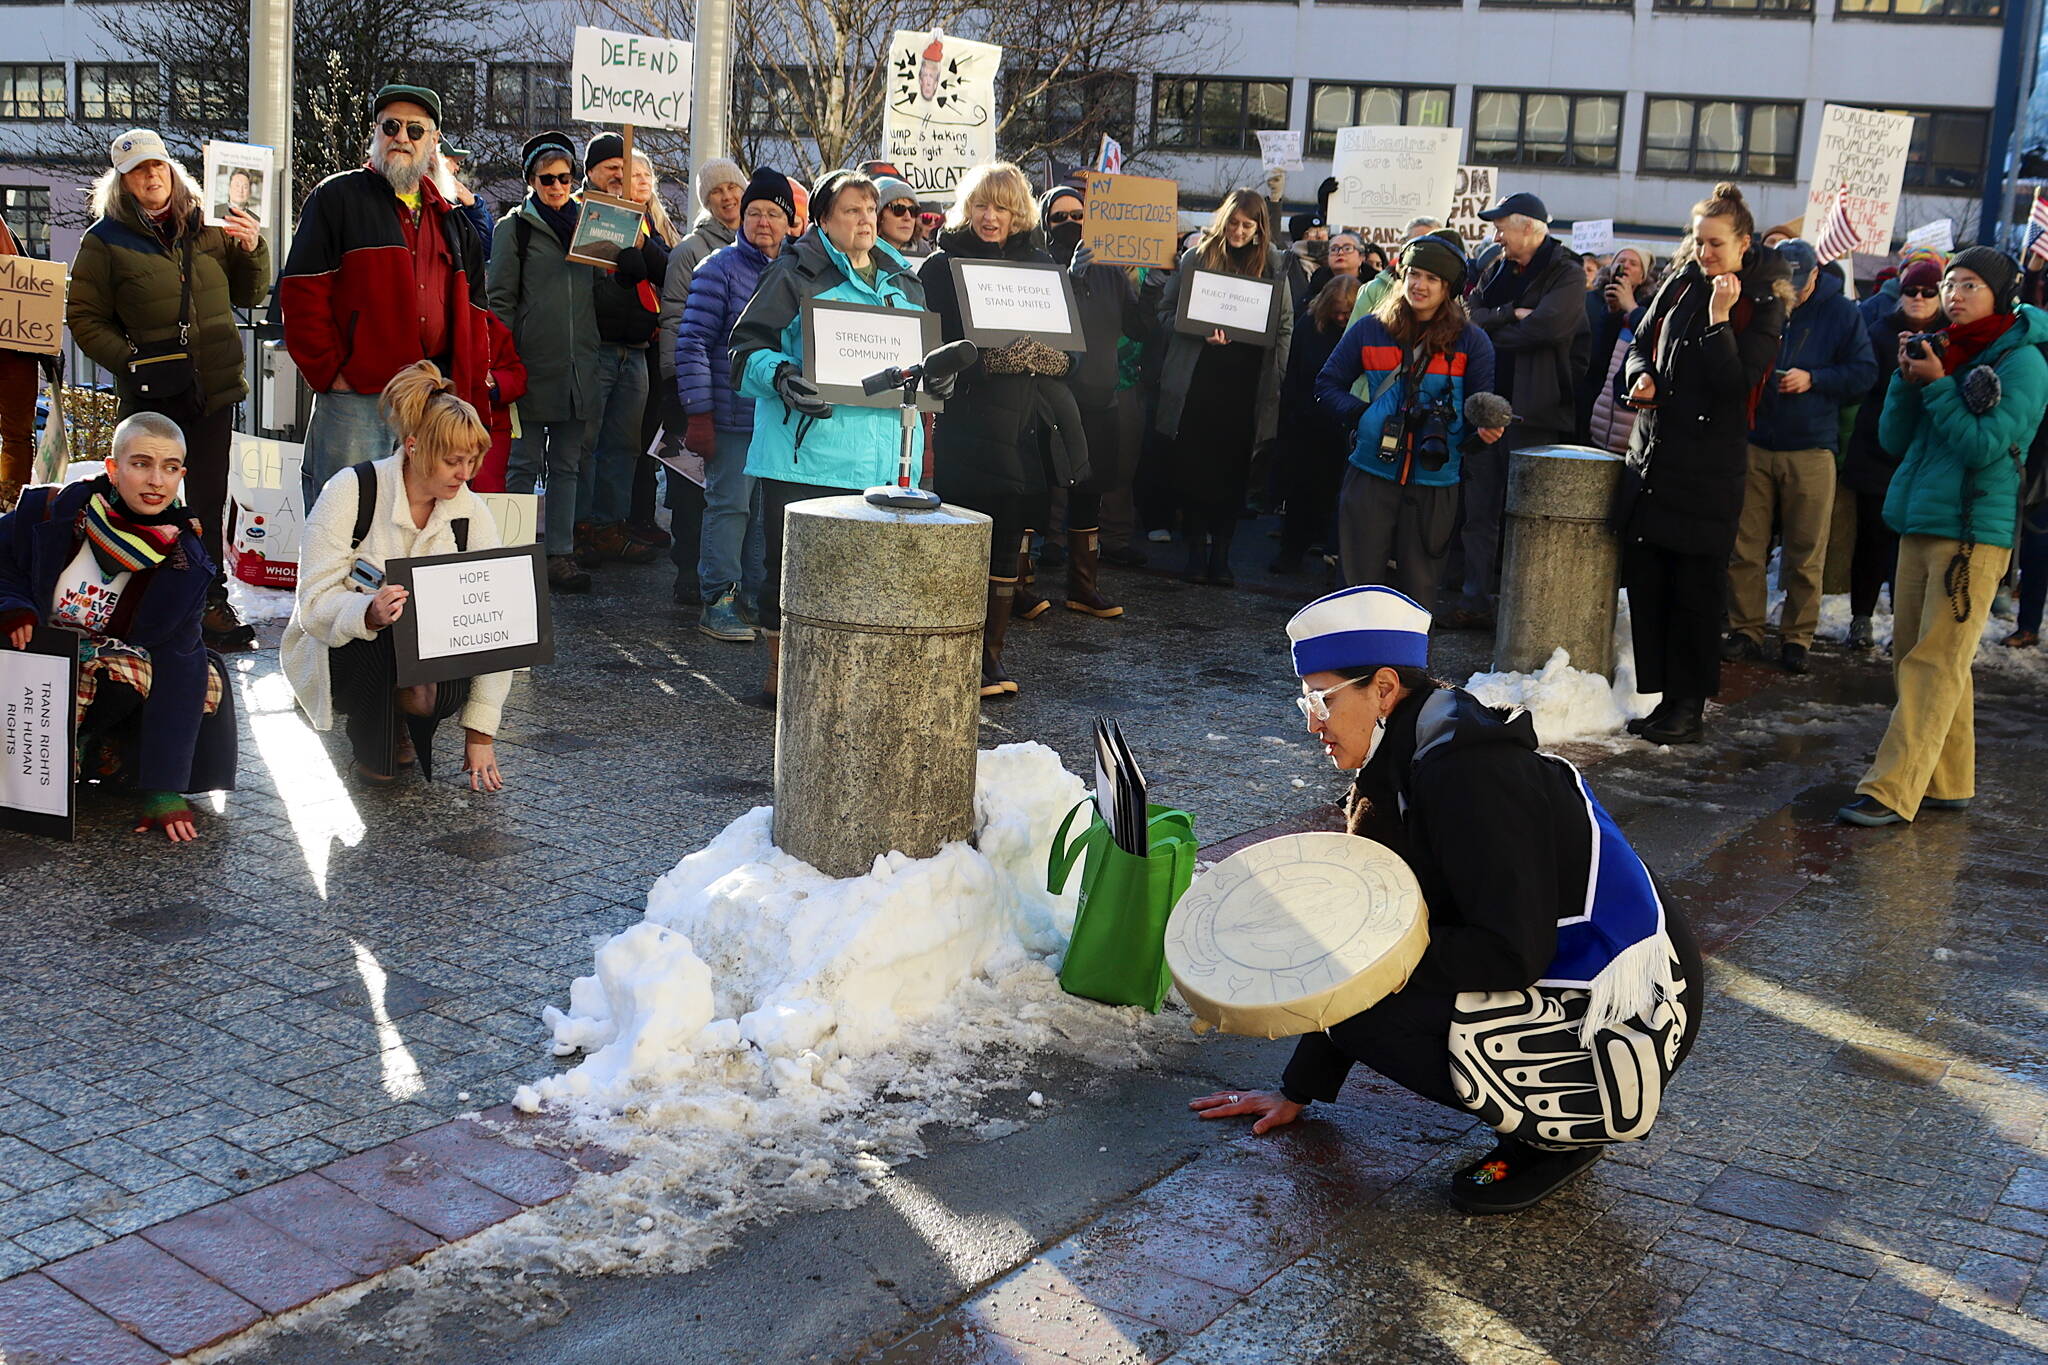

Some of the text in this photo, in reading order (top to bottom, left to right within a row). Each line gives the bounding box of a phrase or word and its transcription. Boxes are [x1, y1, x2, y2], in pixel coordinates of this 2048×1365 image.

[602, 37, 678, 75] DEFEND
[582, 73, 684, 122] DEMOCRACY
[1832, 108, 1905, 130] DUNLEAVY
[932, 129, 968, 148] taking
[1845, 124, 1888, 141] TRUMP
[922, 145, 943, 162] right
[953, 144, 965, 156] to
[1363, 153, 1423, 171] are the
[1092, 177, 1112, 195] MY
[1093, 233, 1163, 261] #RESIST
[977, 282, 1052, 296] WE THE PEOPLE
[1201, 288, 1261, 305] REJECT PROJECT
[984, 297, 1051, 310] STAND UNITED
[1220, 303, 1238, 312] 2025
[0, 298, 54, 342] akes
[835, 331, 901, 346] STRENGTH IN
[839, 347, 900, 361] COMMUNITY
[266, 566, 297, 577] WHOL
[459, 570, 490, 584] HOPE
[462, 591, 491, 605] LOVE
[452, 610, 504, 628] EQUALITY
[449, 630, 509, 649] INCLUSION
[6, 703, 17, 756] RIGHTS
[23, 686, 33, 775] ARE HUMAN
[40, 681, 51, 786] TRANS RIGHTS
